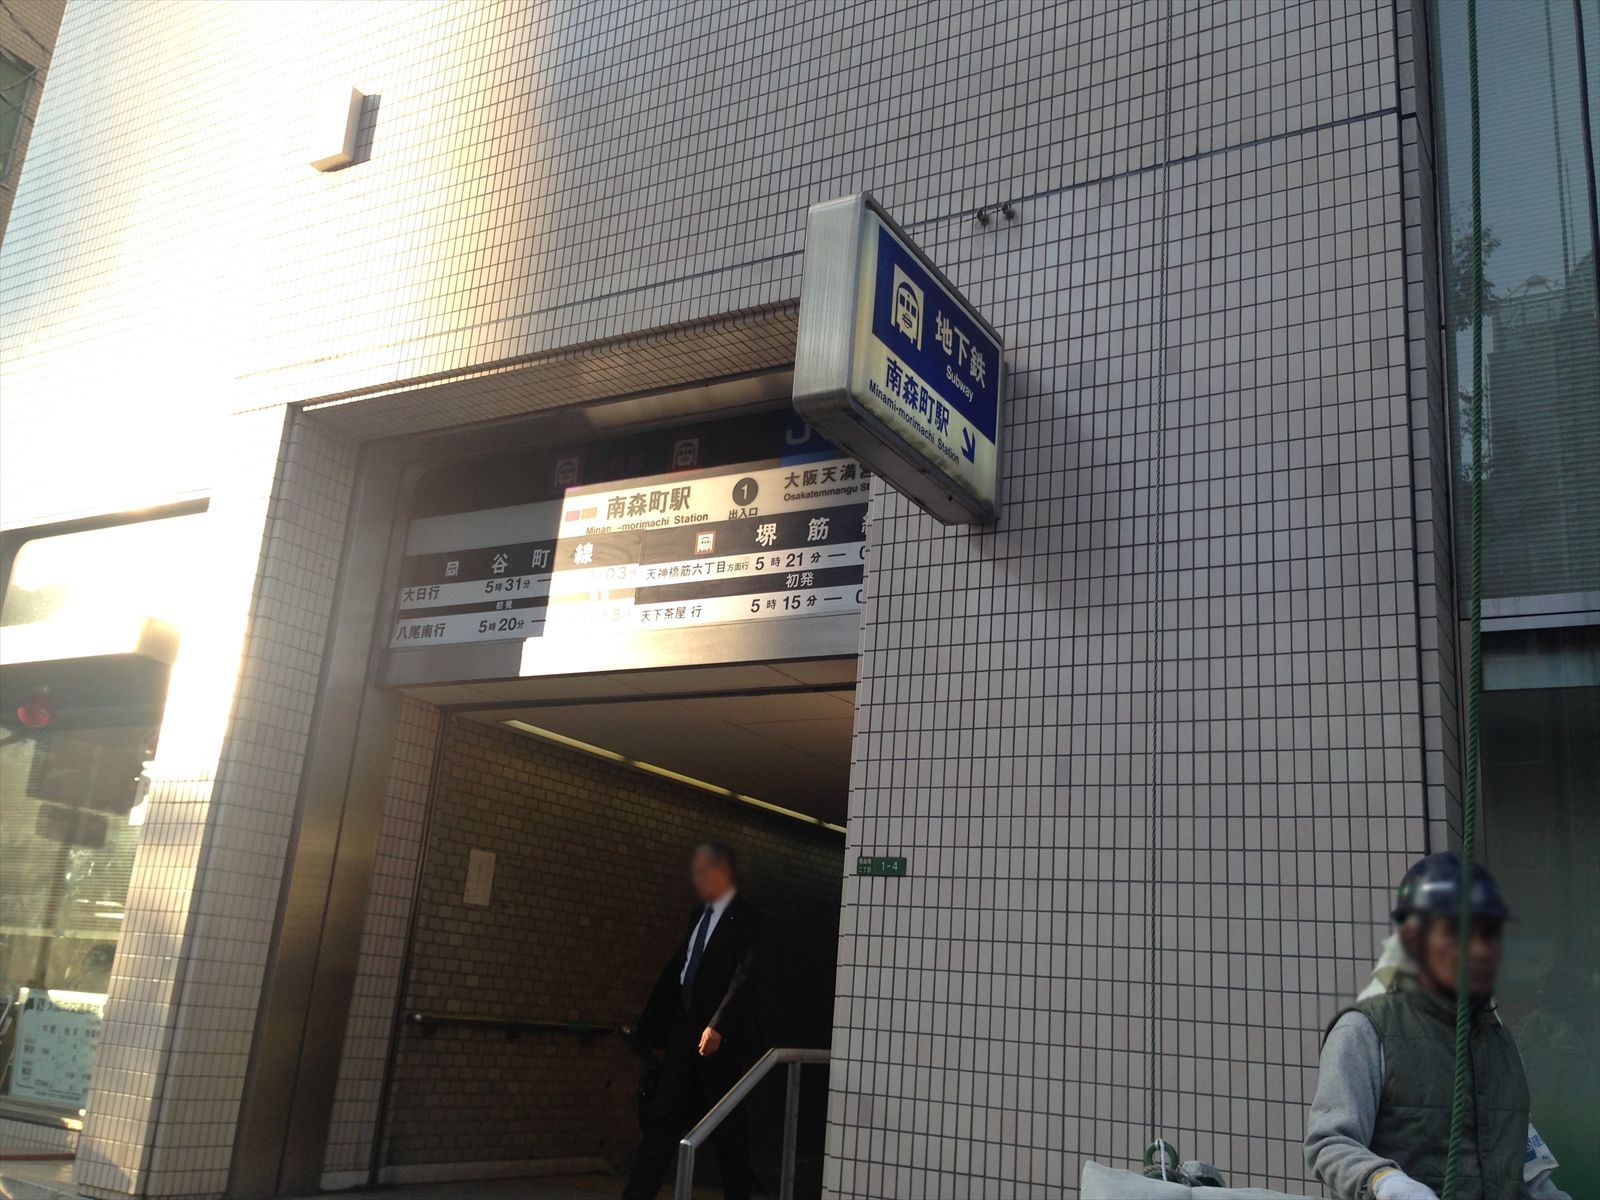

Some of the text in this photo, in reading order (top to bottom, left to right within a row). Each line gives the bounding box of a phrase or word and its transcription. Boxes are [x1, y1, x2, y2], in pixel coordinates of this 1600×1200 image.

[935, 309, 986, 389] 地下鉄
[946, 364, 974, 402] Subway
[886, 356, 949, 437] 南森町駅
[868, 379, 960, 465] Minami-morimachi Station
[740, 482, 748, 499] 1
[783, 484, 858, 502] Osakatemmangu
[606, 486, 691, 520] 南森町駅
[673, 512, 709, 524] Station
[728, 507, 758, 520] 出入口
[785, 571, 814, 588] 初発
[403, 585, 440, 602] 大日行
[396, 623, 446, 640] 八尾南行
[881, 861, 898, 871] 1-4
